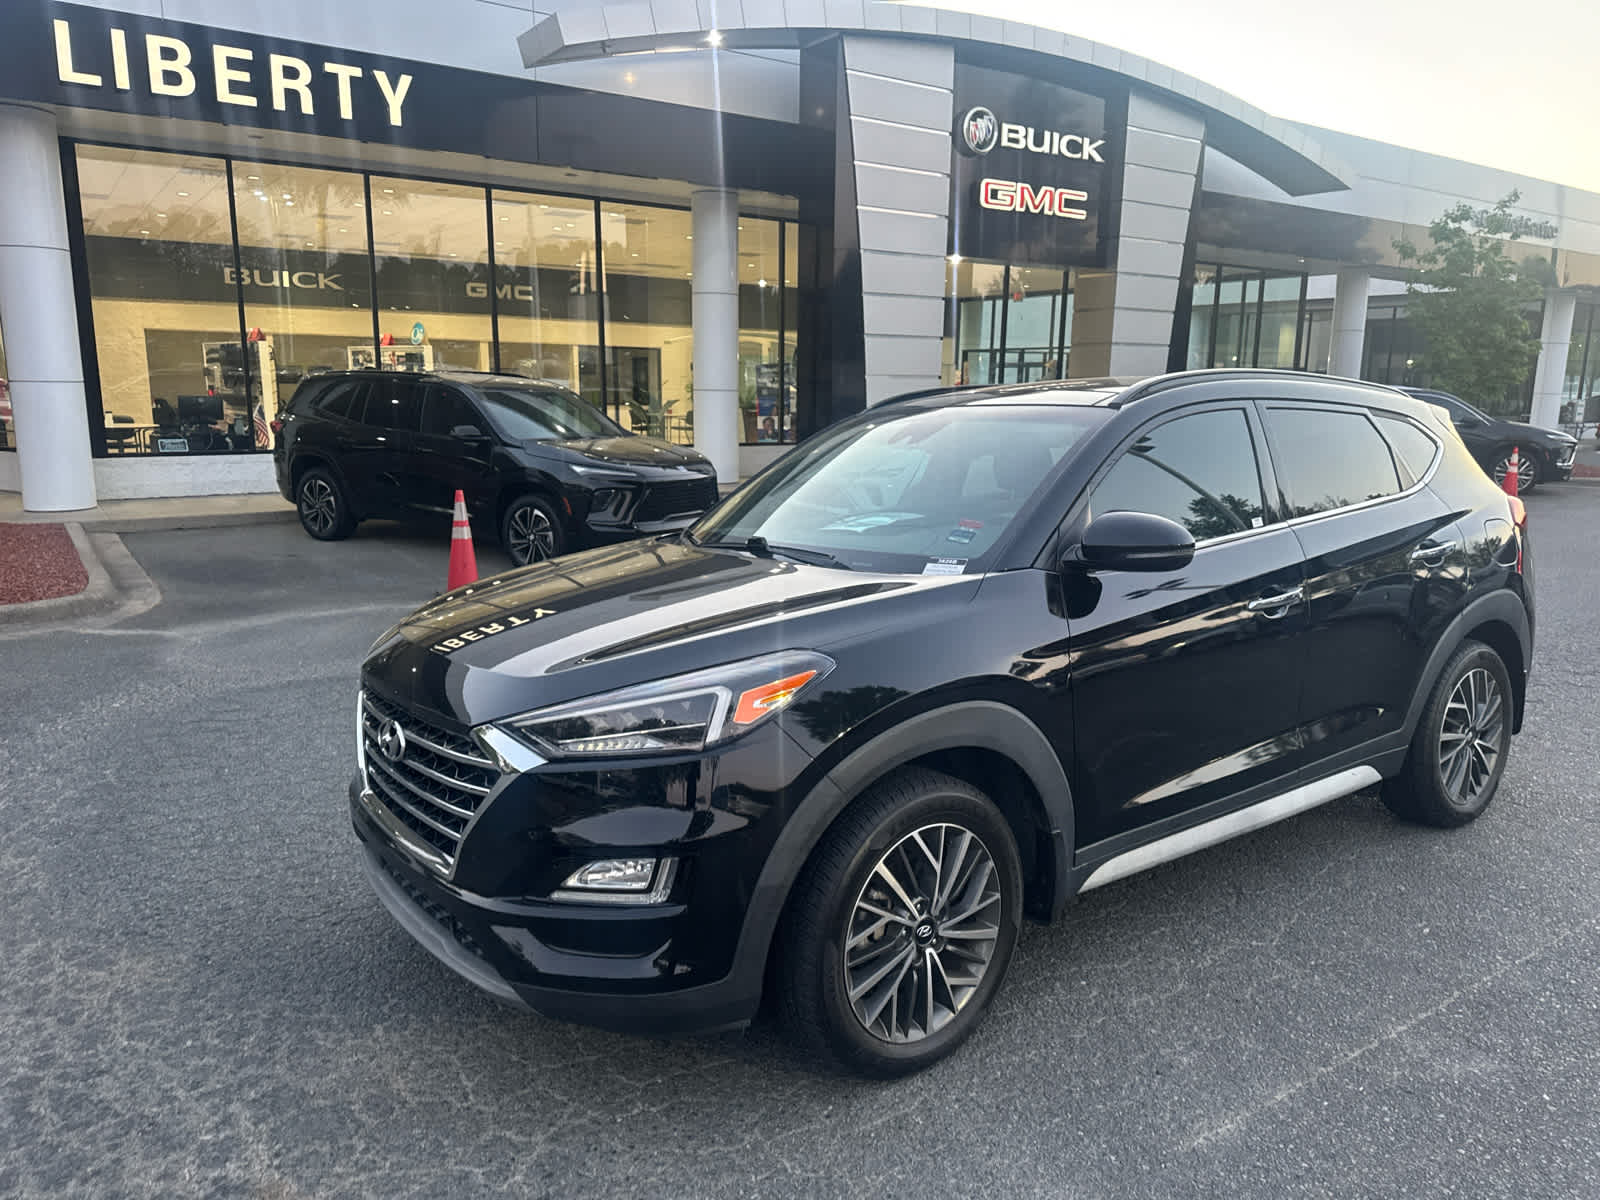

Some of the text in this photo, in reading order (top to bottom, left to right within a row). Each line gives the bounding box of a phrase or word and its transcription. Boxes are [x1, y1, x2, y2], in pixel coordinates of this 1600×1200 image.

[53, 19, 413, 127] LIBERTY
[1000, 122, 1106, 163] BUICK
[979, 178, 1088, 220] GMC
[223, 266, 344, 291] BUICK
[465, 281, 534, 301] GMC
